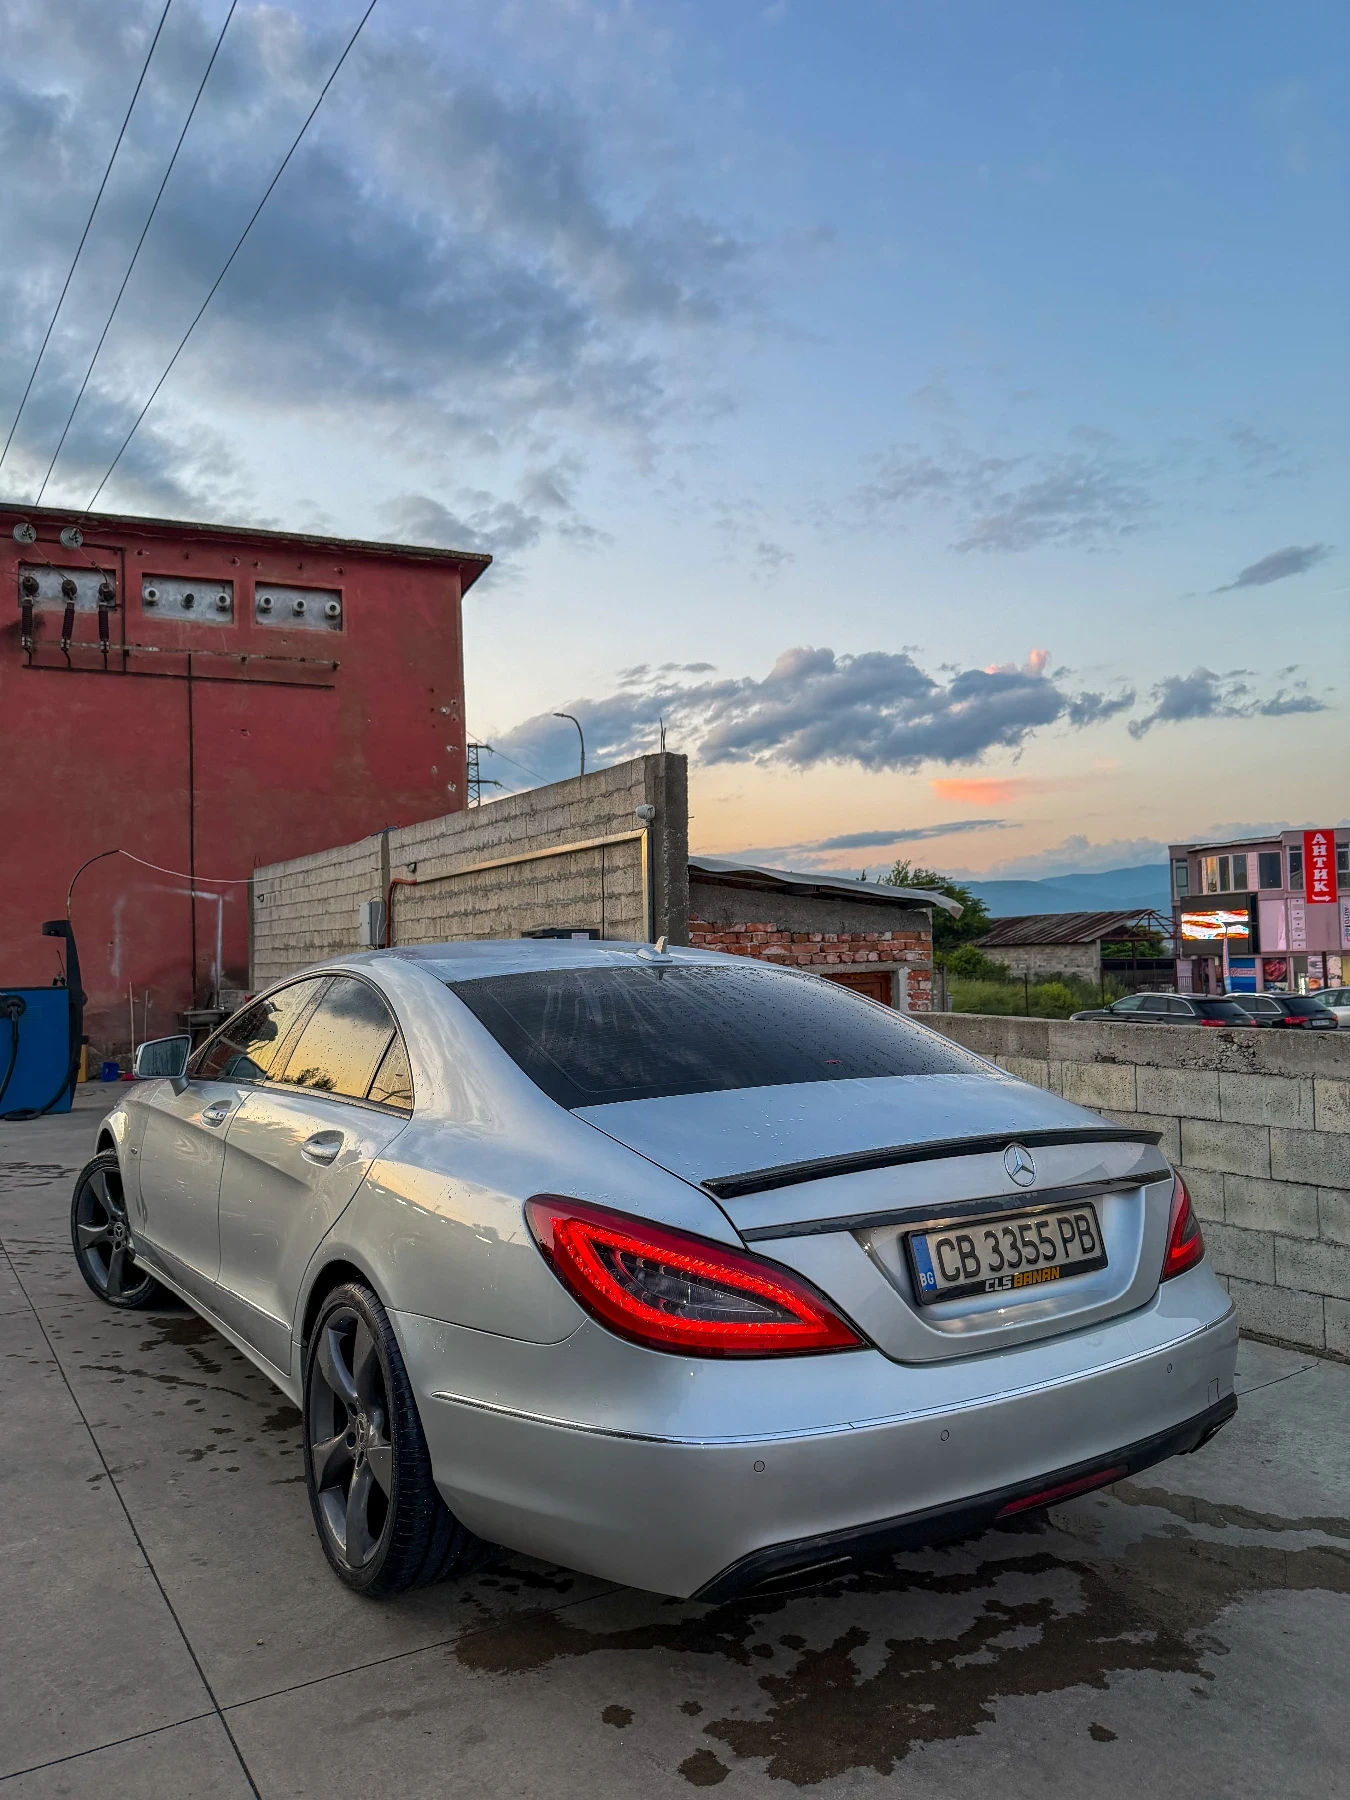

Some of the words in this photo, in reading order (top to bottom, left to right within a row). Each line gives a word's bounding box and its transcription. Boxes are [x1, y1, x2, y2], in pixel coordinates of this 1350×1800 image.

[1311, 833, 1329, 892] АНТИК
[936, 1235, 981, 1281] CB
[984, 1220, 1057, 1272] 3355
[1056, 1214, 1096, 1258] PB
[920, 1272, 935, 1286] BG
[985, 1275, 1013, 1292] CLS
[1013, 1266, 1060, 1288] BANAN
